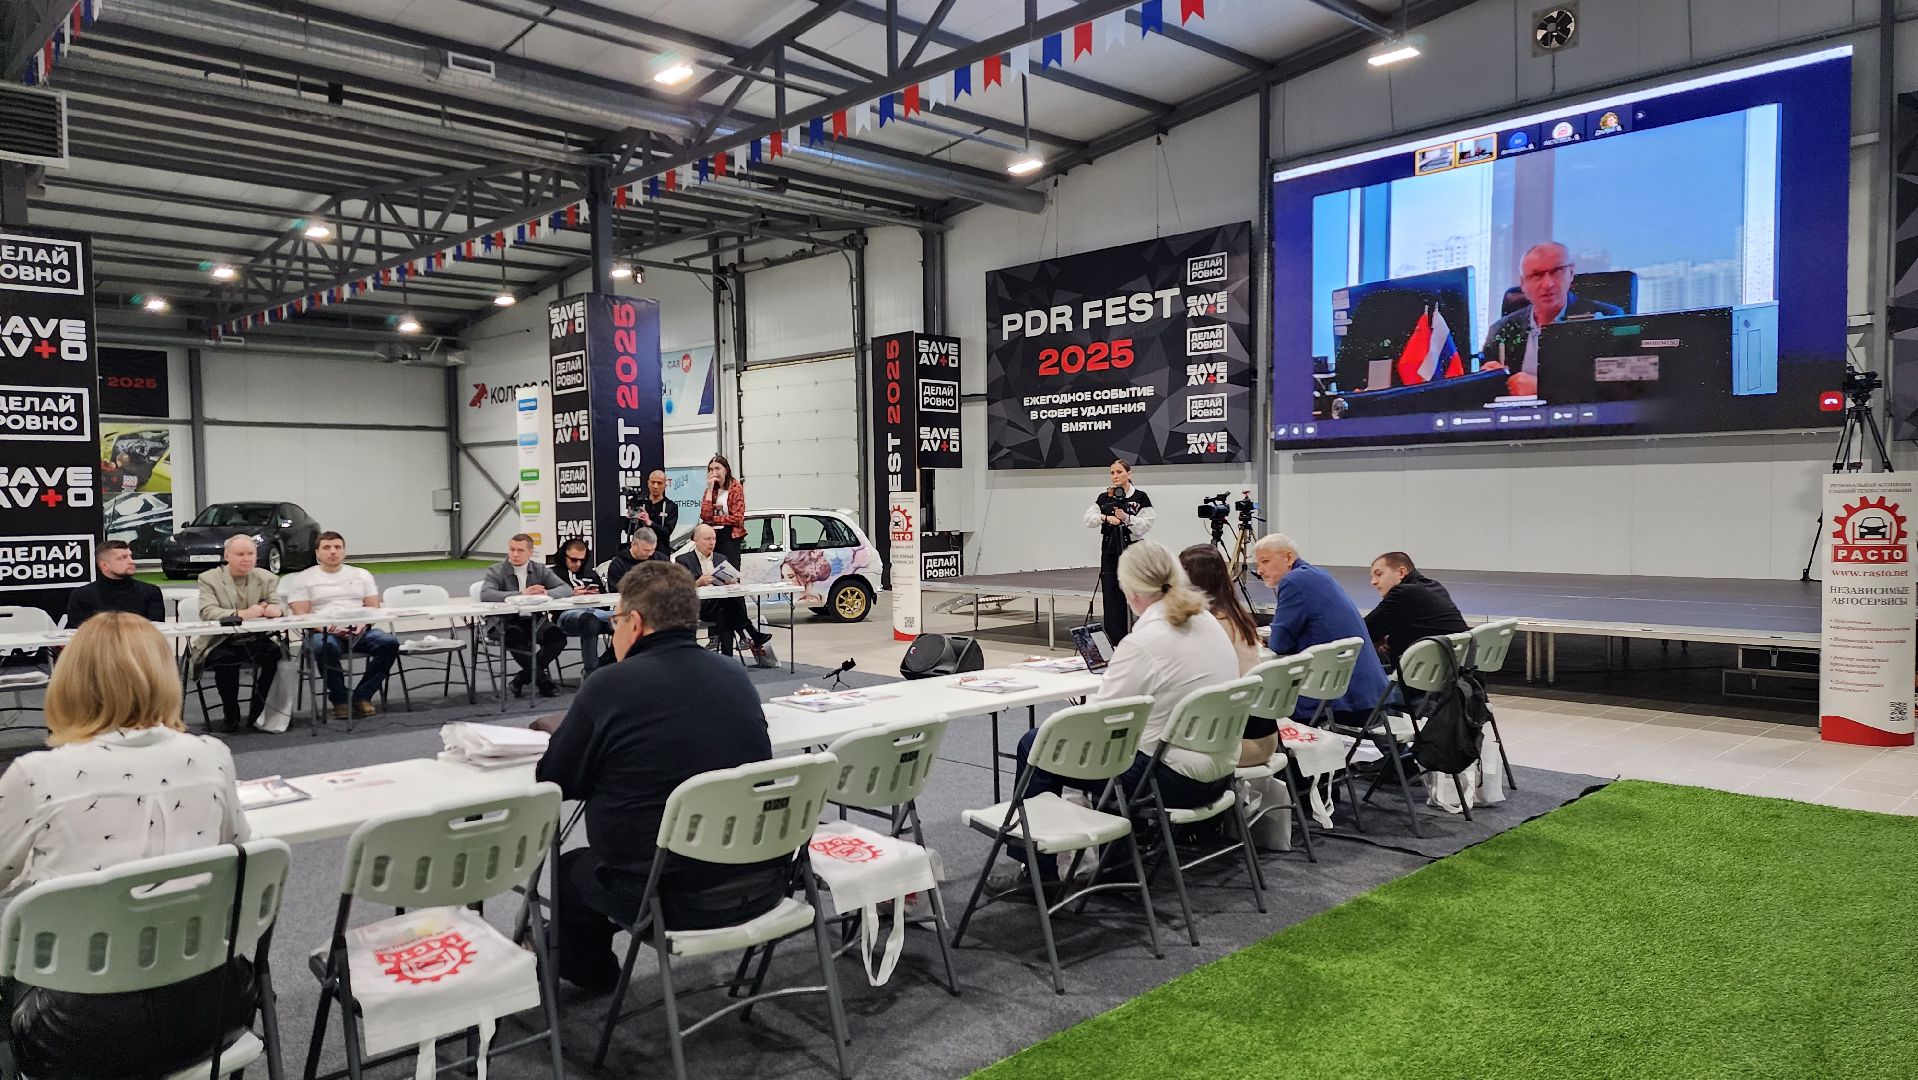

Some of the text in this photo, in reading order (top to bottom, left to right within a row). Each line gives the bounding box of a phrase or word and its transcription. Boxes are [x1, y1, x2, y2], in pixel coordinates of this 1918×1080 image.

[0, 246, 69, 266] ЕЛАЙ
[1191, 257, 1223, 271] ДЕЛАЙ
[0, 263, 71, 284] ОВНО
[1191, 267, 1224, 280] РОВНО
[1186, 290, 1228, 308] SAVE
[549, 300, 585, 325] SAVE
[1002, 287, 1181, 341] PDR FEST
[0, 315, 87, 341] AVE
[1191, 328, 1223, 343] ДЕЛАЙ
[918, 339, 959, 356] SAVE
[1191, 339, 1224, 351] РОВНО
[613, 303, 639, 410] 2025
[1038, 338, 1135, 376] 2025
[555, 357, 582, 376] ДЕЛАЙ
[1186, 361, 1228, 376] SAVE
[556, 372, 583, 388] РОВНО
[923, 385, 955, 397] ДЕЛАЙ
[1023, 385, 1155, 406] ЕЖЕГОДНОЕ СОБЫТИЕ
[923, 397, 955, 408] РОВНО
[1191, 397, 1223, 410] ДЕЛАЙ
[886, 339, 902, 492] 2025 EST
[1030, 401, 1146, 420] В СФЕРЕ УДАЛЕНИЯ
[1191, 407, 1224, 418] РОВНО
[554, 409, 588, 428] SAVE
[919, 426, 960, 440] SAVE
[1061, 420, 1112, 433] ВМЯТИН
[1186, 431, 1228, 445] SAVE
[559, 467, 586, 483] ДЕЛАЙ
[560, 482, 587, 495] РОВНО
[557, 519, 593, 536] SAVE
[0, 541, 82, 564] ДЕЛАЙ
[1837, 549, 1904, 561] РАСТО
[926, 556, 957, 570] ДЕЛАЙ
[0, 562, 84, 580] РОВНО
[926, 568, 957, 579] РОВНО
[1831, 569, 1909, 578] www.rasto.net
[1830, 585, 1910, 595] НЕЗАВИСИМЫЕ
[1831, 597, 1908, 606] АВТОСЕРВИСЫ
